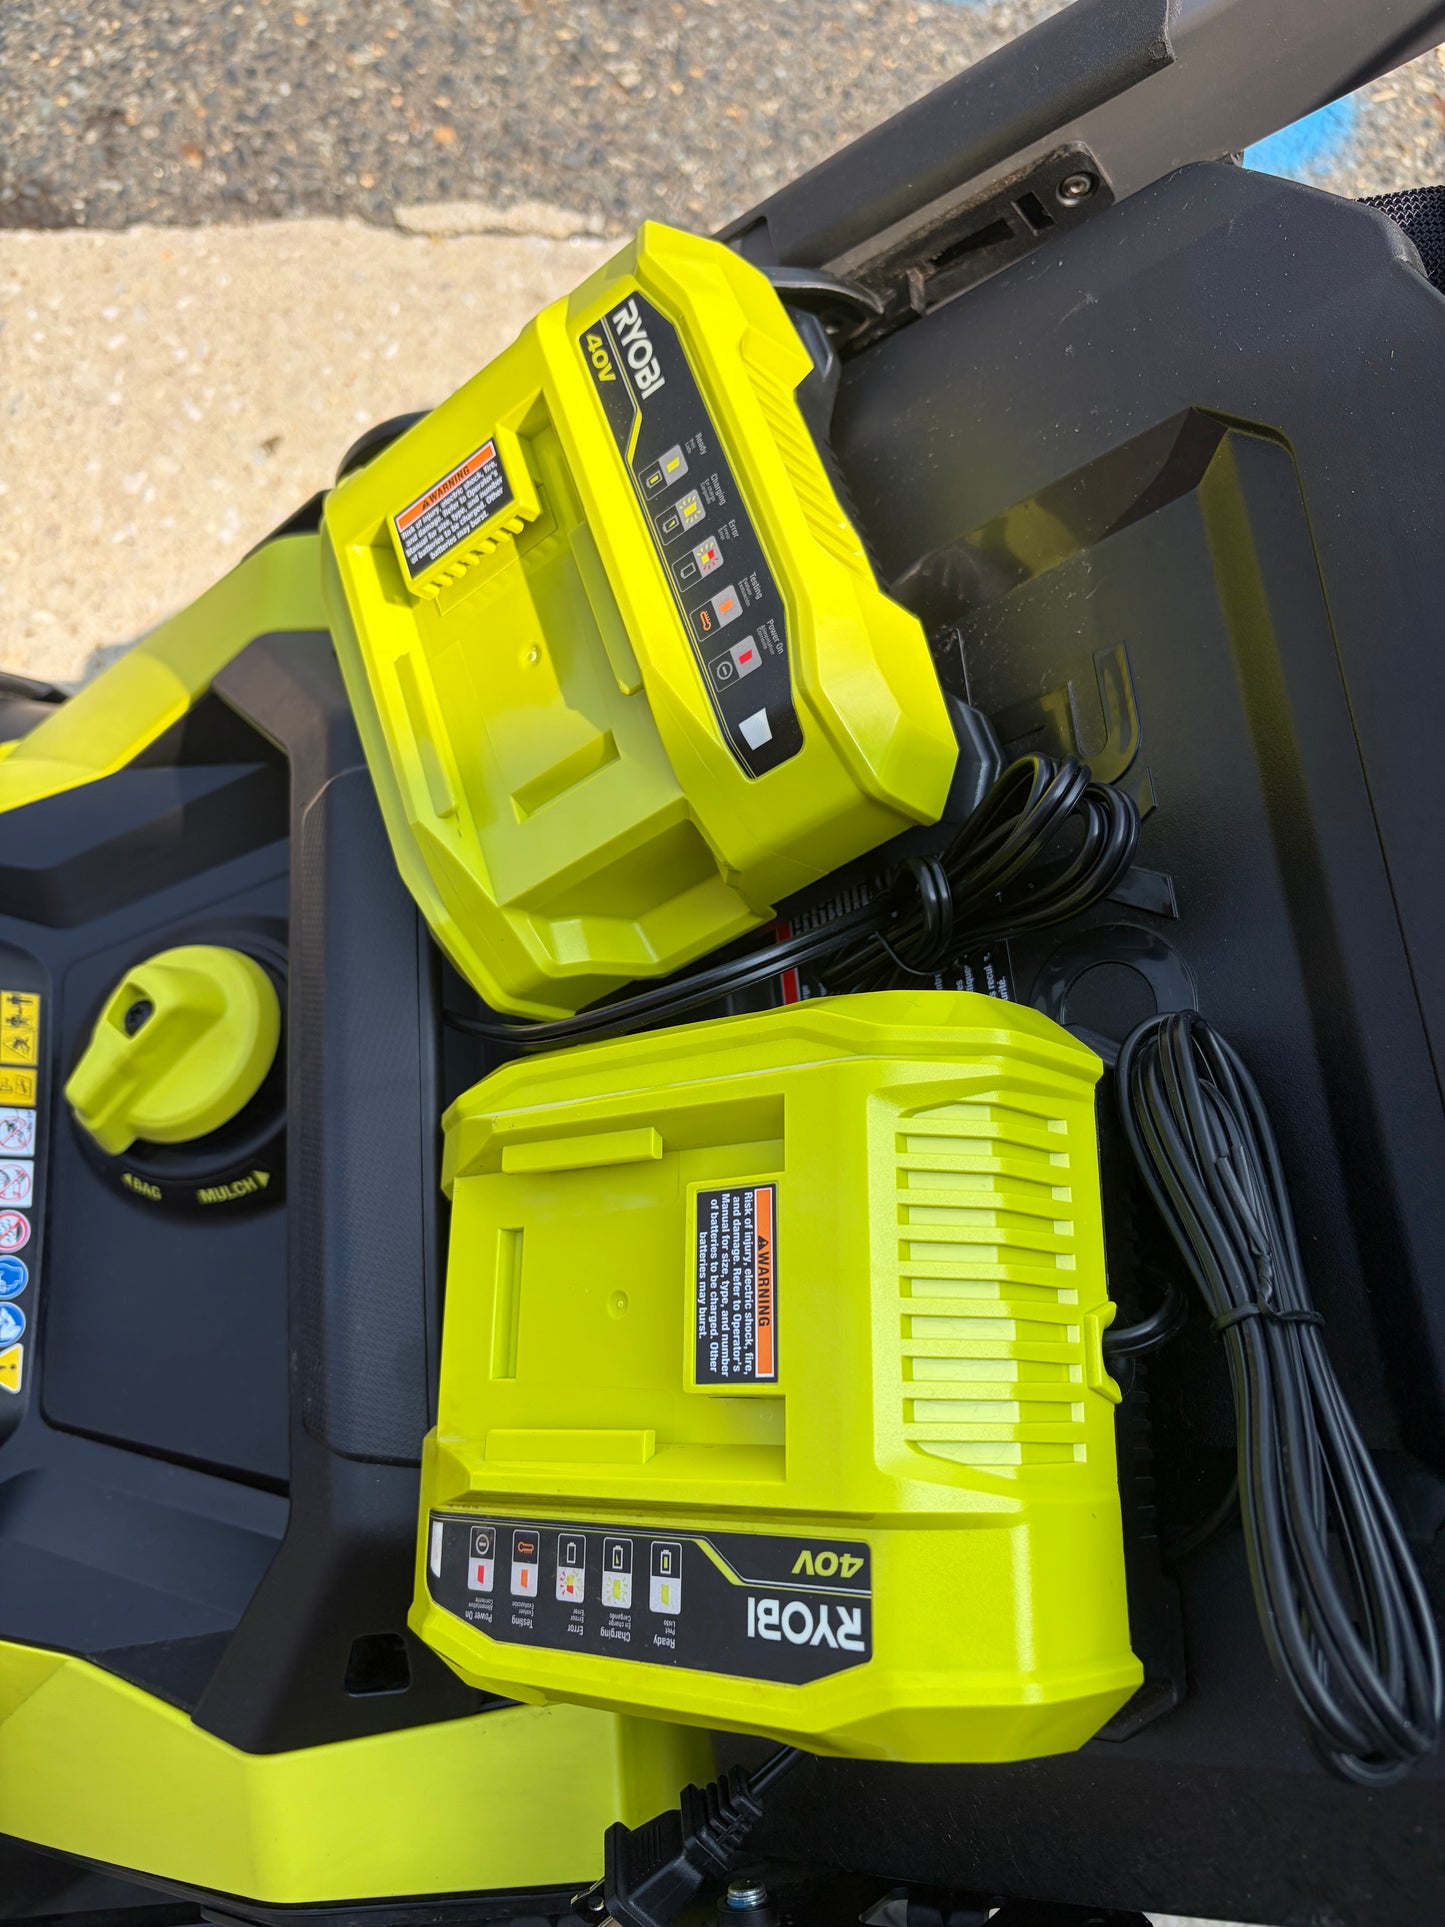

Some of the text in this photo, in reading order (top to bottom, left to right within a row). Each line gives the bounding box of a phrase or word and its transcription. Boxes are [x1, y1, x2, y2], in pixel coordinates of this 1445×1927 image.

[585, 334, 617, 382] 40V
[612, 298, 666, 400] RYOBI
[695, 432, 707, 455] Ready
[429, 465, 470, 503] WARNING
[710, 473, 726, 506] Charging
[728, 519, 739, 538] Error
[749, 571, 763, 600] Testing
[767, 618, 784, 655] Power On
[131, 1176, 162, 1201] BAG
[195, 1176, 258, 1204] MULCH
[697, 1231, 707, 1339] batteries may burst.
[707, 1198, 718, 1372] of batteries to be charged. Other
[719, 1193, 730, 1376] Manual for size, type, and number
[730, 1196, 741, 1372] and damage. Refer to Operator's
[742, 1191, 753, 1375] Risk of injury, electric shock, fire,
[757, 1251, 770, 1327] WARNING
[791, 1550, 864, 1578] 40V
[465, 1610, 493, 1622] Power On
[511, 1614, 533, 1629] Testing
[567, 1624, 584, 1636] Error
[747, 1596, 865, 1652] RYOBI
[600, 1626, 631, 1642] Charging
[653, 1634, 676, 1649] Ready
